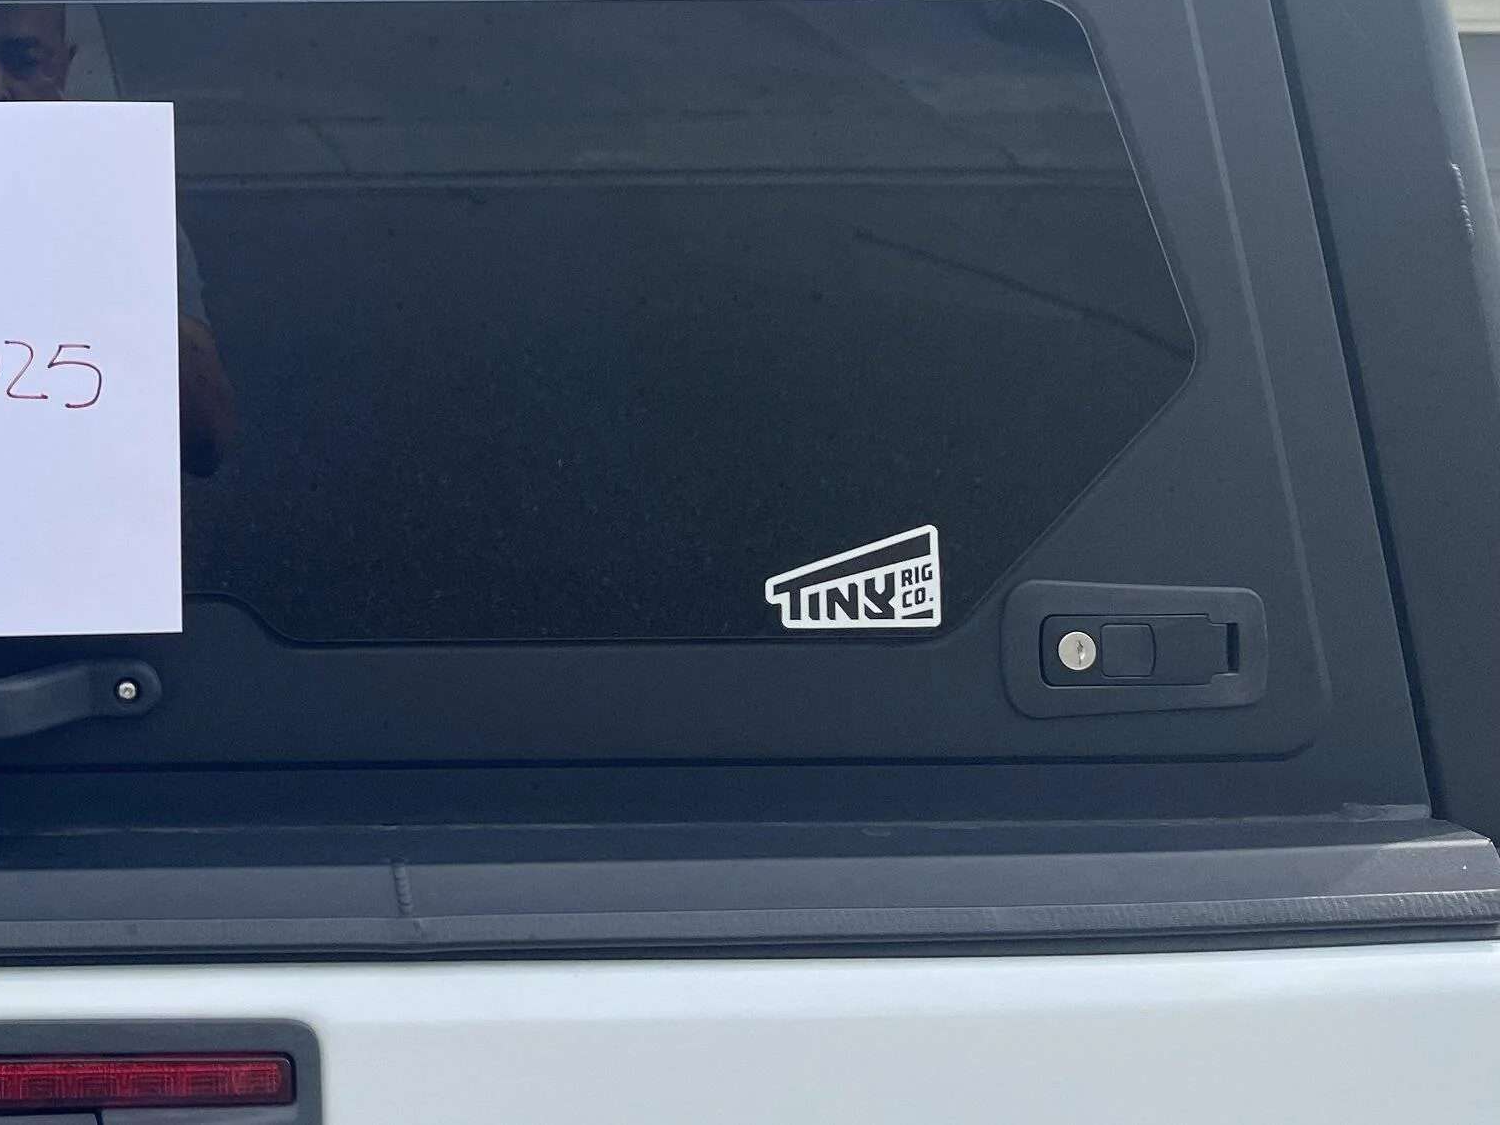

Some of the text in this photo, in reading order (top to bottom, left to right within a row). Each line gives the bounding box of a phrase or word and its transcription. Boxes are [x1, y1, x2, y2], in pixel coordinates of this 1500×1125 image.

[901, 563, 933, 586] RIG
[773, 572, 896, 621] TINY
[902, 586, 934, 609] CO.
